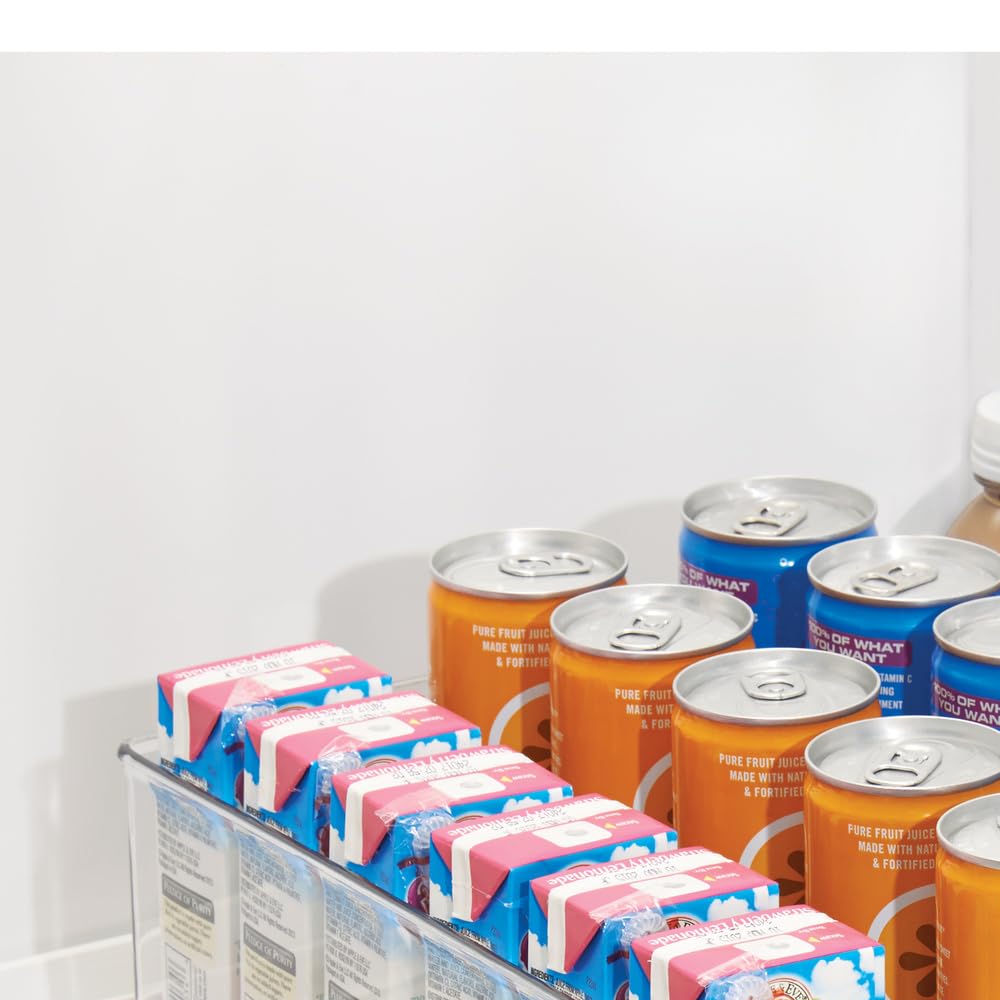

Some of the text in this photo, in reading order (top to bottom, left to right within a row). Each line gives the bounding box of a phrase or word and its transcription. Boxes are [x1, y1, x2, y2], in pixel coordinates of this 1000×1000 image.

[706, 573, 750, 593] WHAT
[472, 624, 526, 639] PURE FRUIT
[482, 641, 534, 654] MADE WITH
[831, 633, 904, 654] OF WHAT
[839, 647, 887, 664] WANT
[615, 688, 673, 700] PURE FRUIT
[939, 698, 961, 716] YOU
[957, 696, 976, 707] OF
[626, 704, 652, 715] MADE
[719, 753, 775, 768] PURE FRUIT
[729, 770, 784, 783] MADE WITH
[847, 823, 935, 839] PURE FRUIT JUICE
[858, 840, 913, 854] MADE WITH
[883, 858, 935, 870] FORTIFIED
